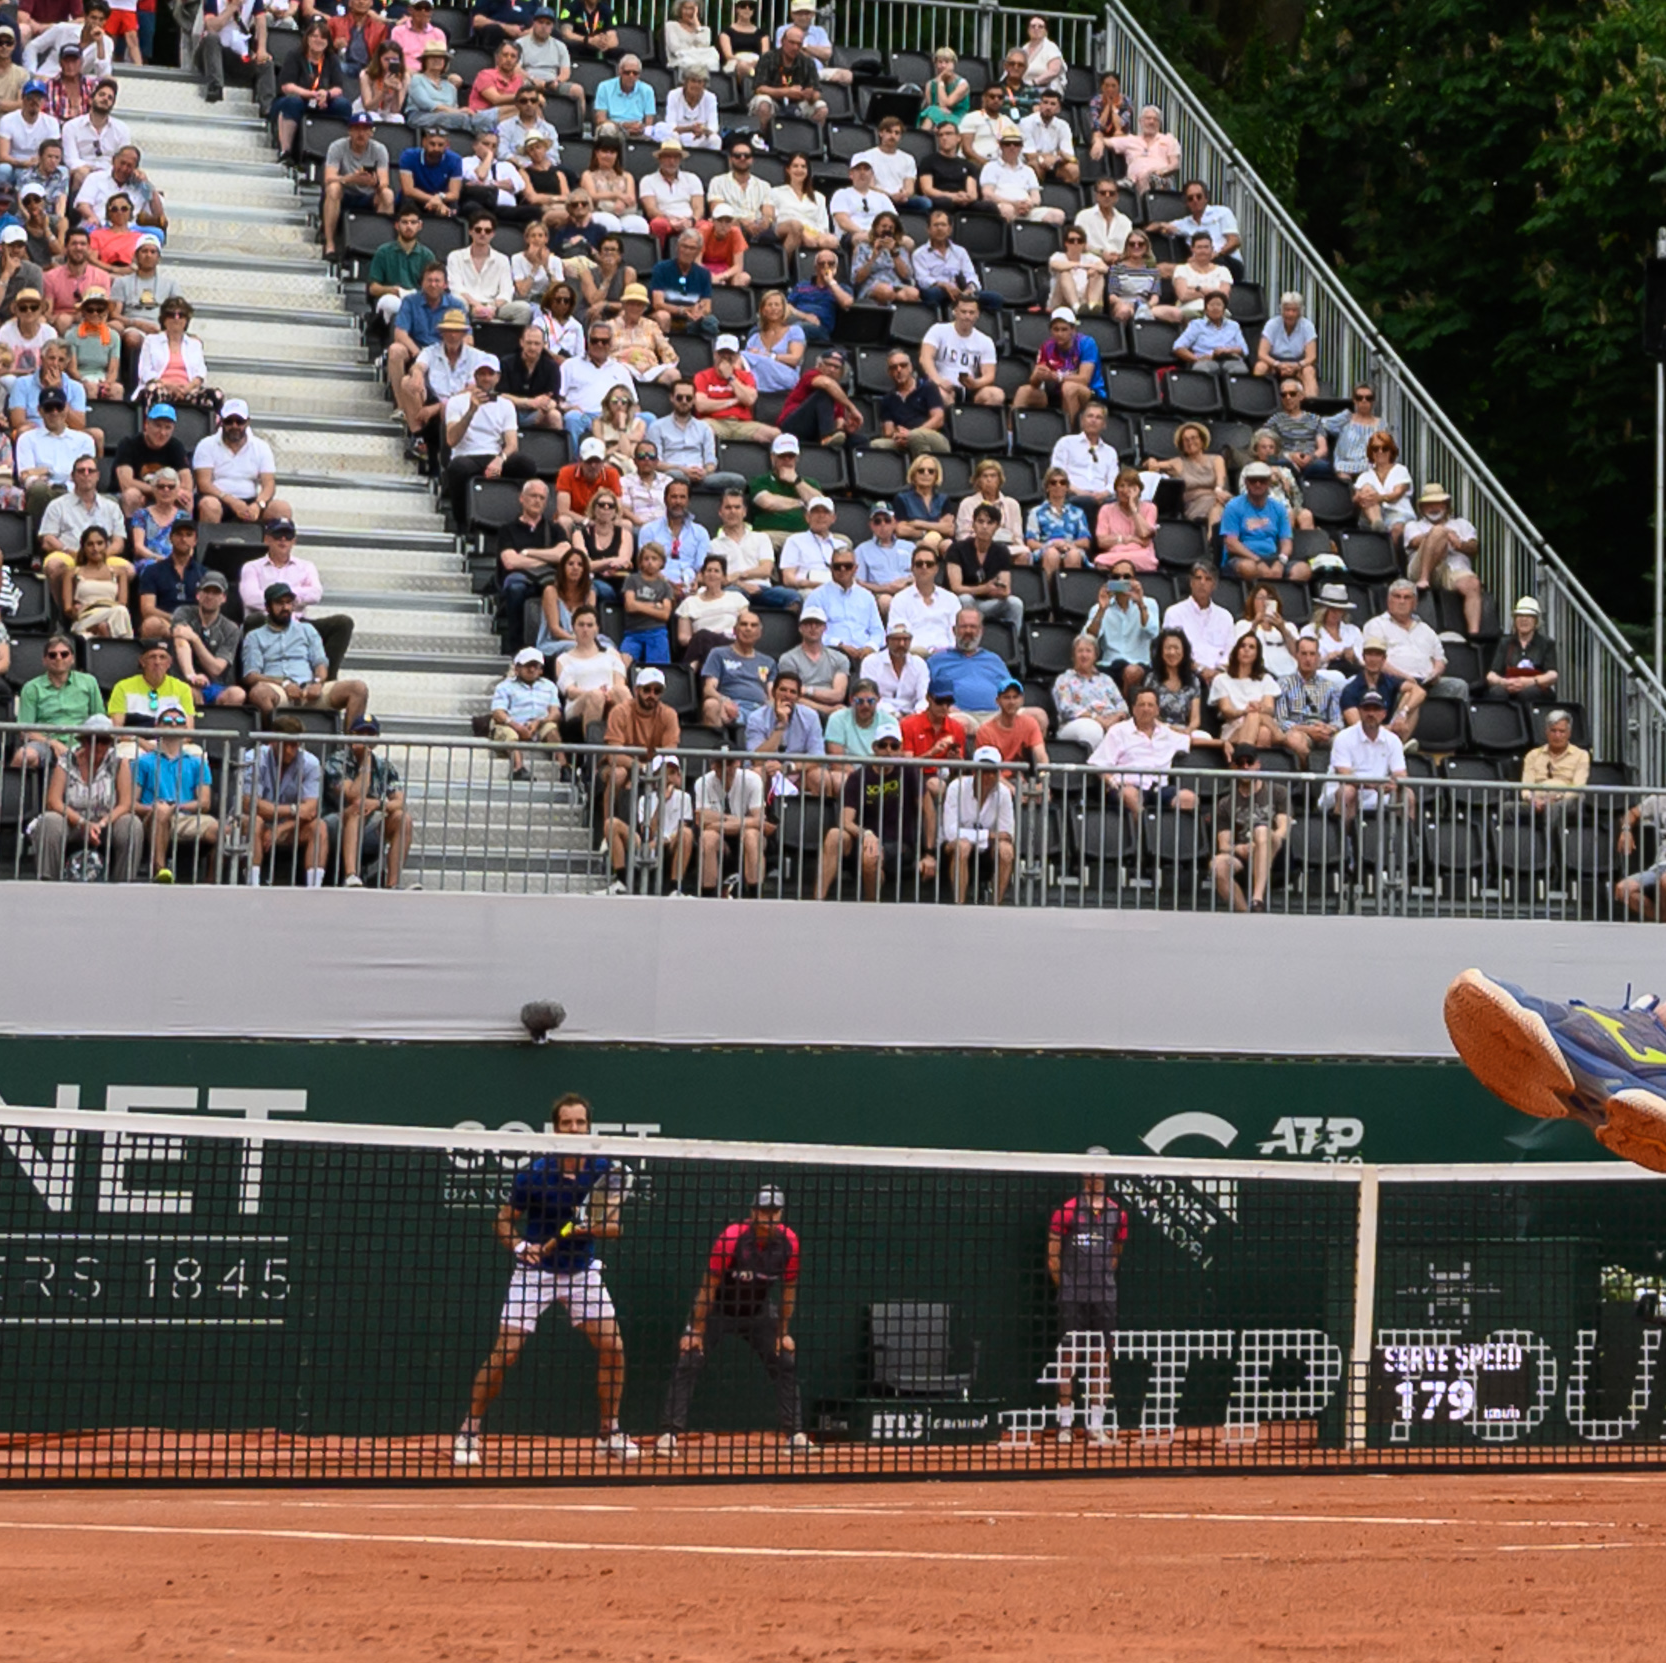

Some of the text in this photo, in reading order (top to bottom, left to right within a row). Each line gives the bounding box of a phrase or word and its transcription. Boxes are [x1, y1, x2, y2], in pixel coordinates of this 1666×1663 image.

[1255, 1117, 1365, 1155] ATP
[143, 1257, 291, 1301] 1845
[1384, 1343, 1523, 1372] SERVE SPEED
[998, 1330, 1342, 1446] ATP
[1395, 1380, 1474, 1420] 179
